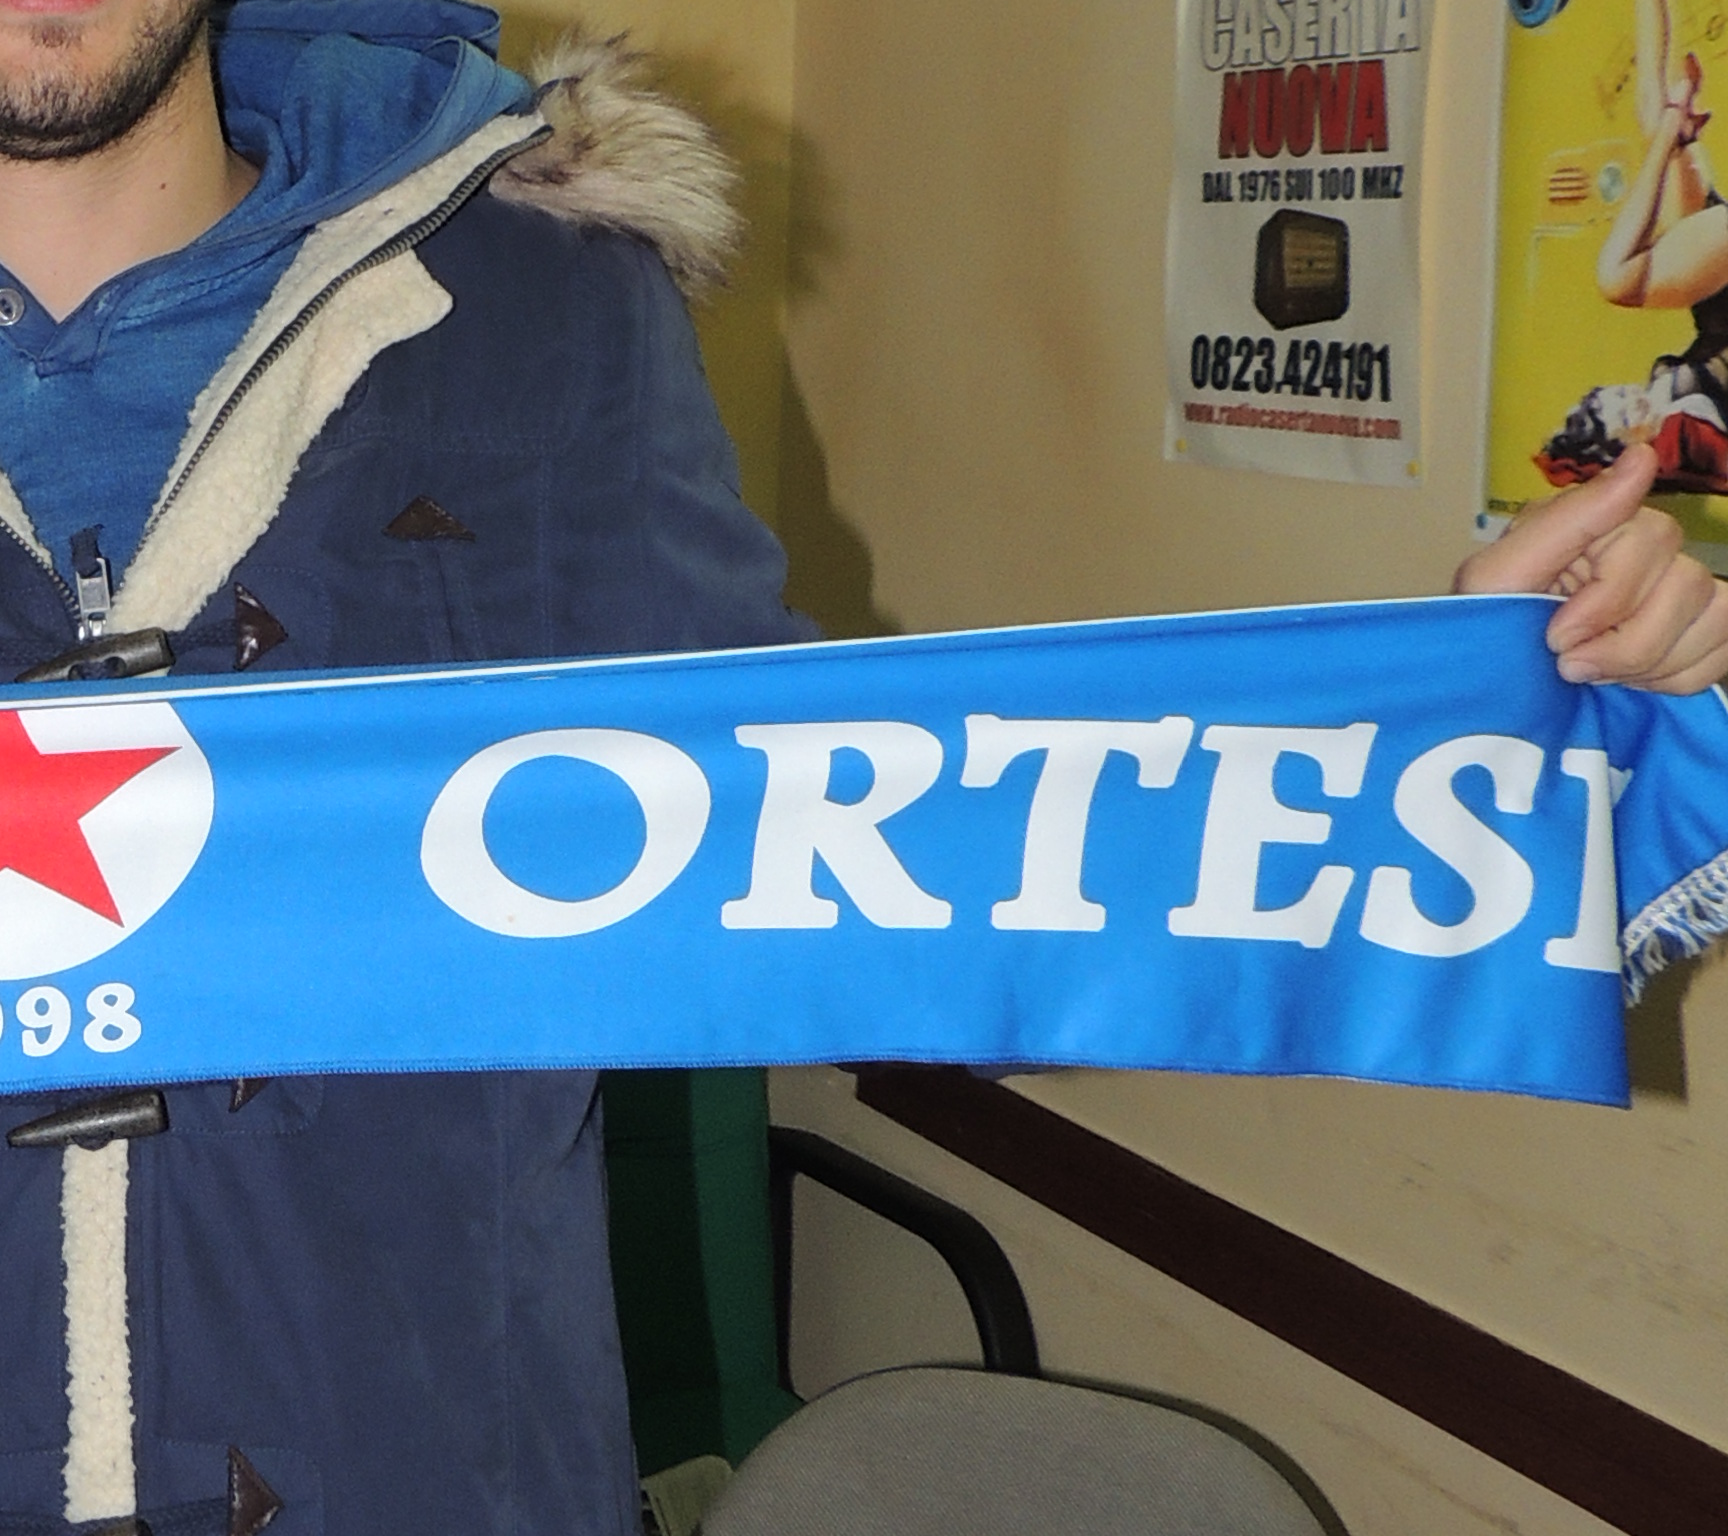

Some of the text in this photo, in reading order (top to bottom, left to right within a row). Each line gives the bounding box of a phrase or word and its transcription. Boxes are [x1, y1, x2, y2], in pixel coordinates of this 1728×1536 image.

[1218, 58, 1390, 160] NUOVA
[1202, 164, 1404, 203] DAL 1976 SUI 100 MHZ
[1190, 334, 1392, 402] 0823.424191
